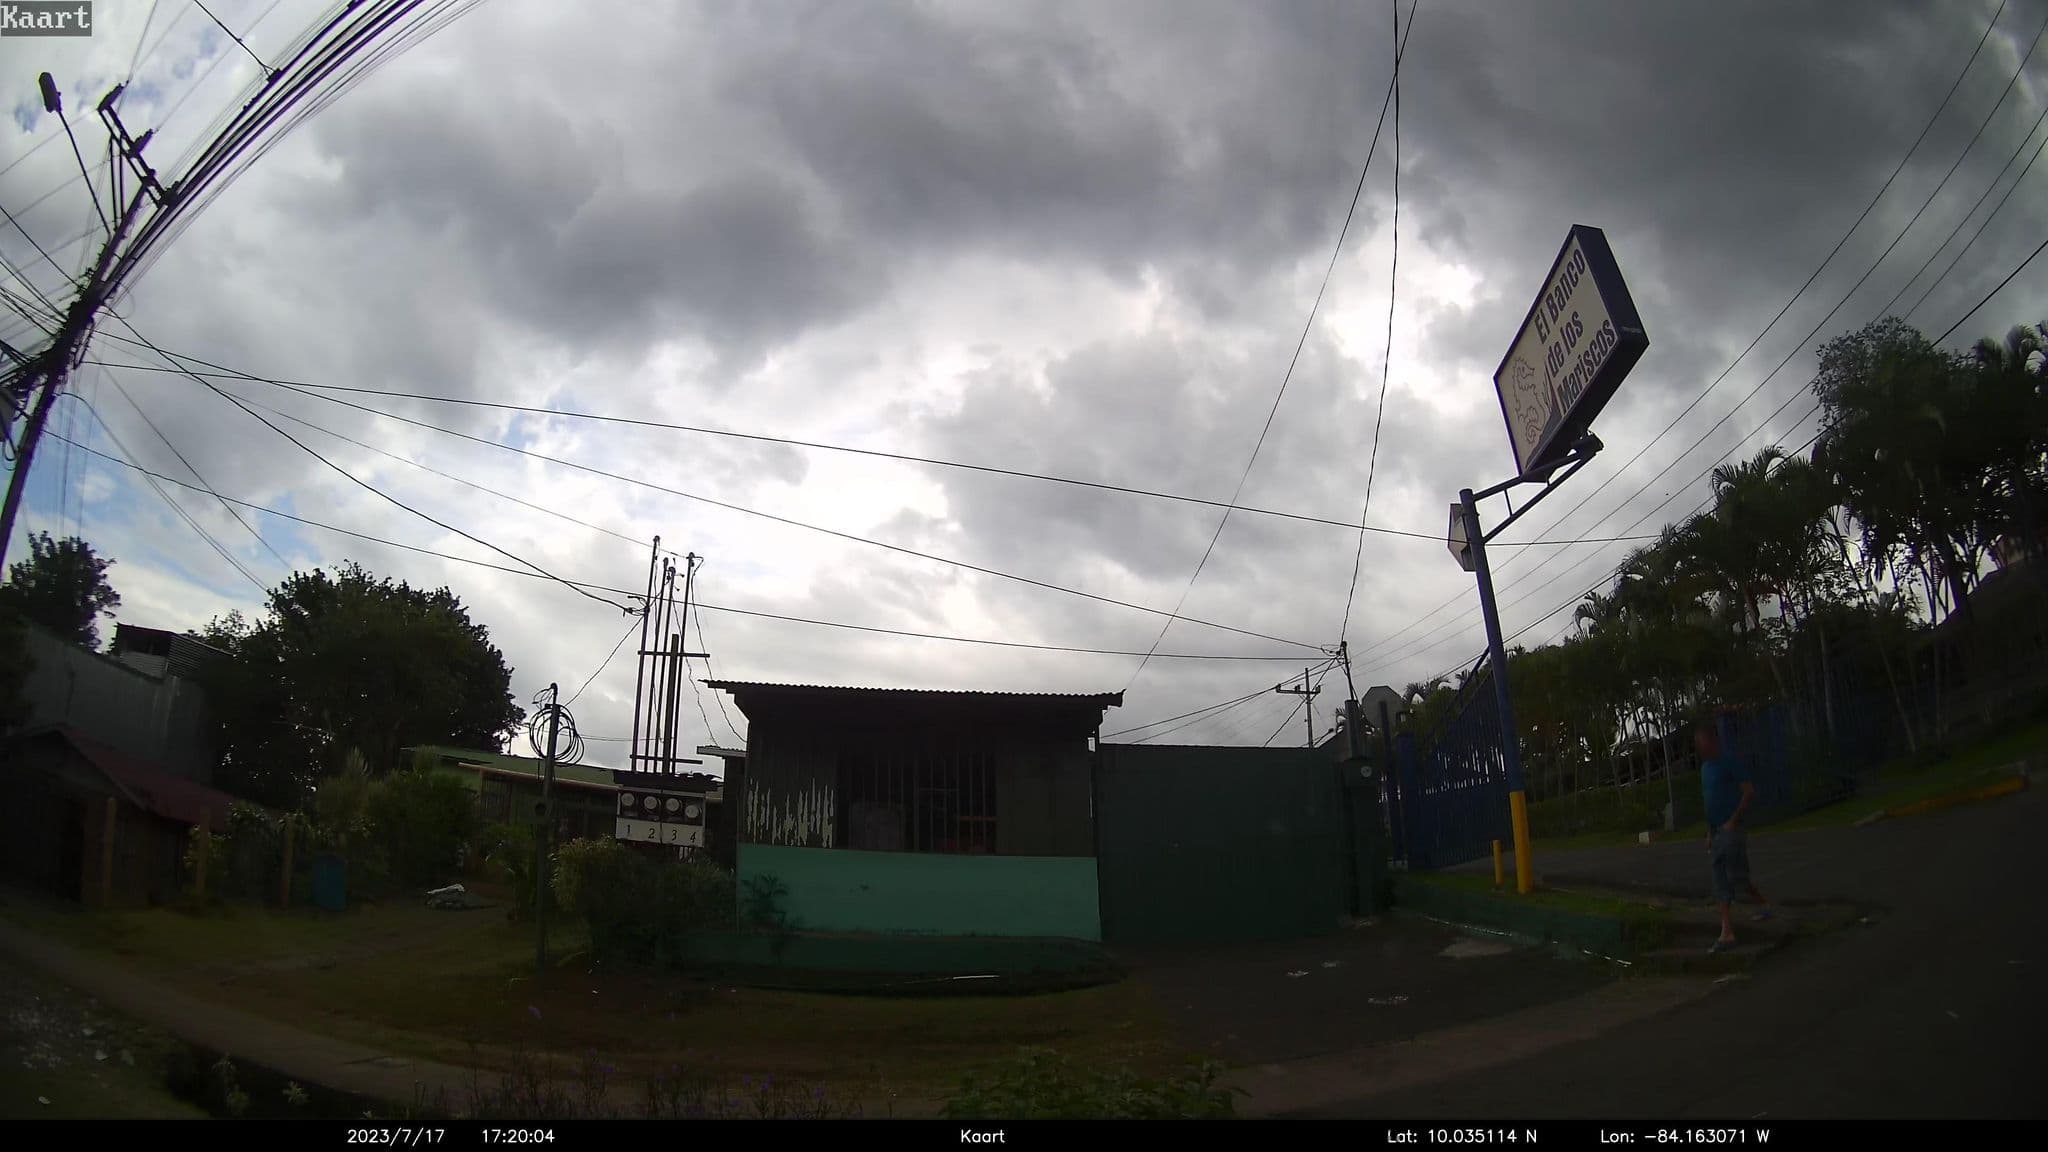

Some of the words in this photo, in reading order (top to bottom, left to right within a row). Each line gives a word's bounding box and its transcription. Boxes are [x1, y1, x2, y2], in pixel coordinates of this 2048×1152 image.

[1534, 307, 1549, 345] El
[1546, 248, 1585, 325] Banco
[1547, 342, 1566, 378] de
[1560, 311, 1584, 351] los
[1556, 319, 1616, 413] Mariscos
[626, 824, 631, 835] 1
[647, 828, 656, 839] 2
[671, 829, 678, 841] 3
[689, 831, 697, 843] 4
